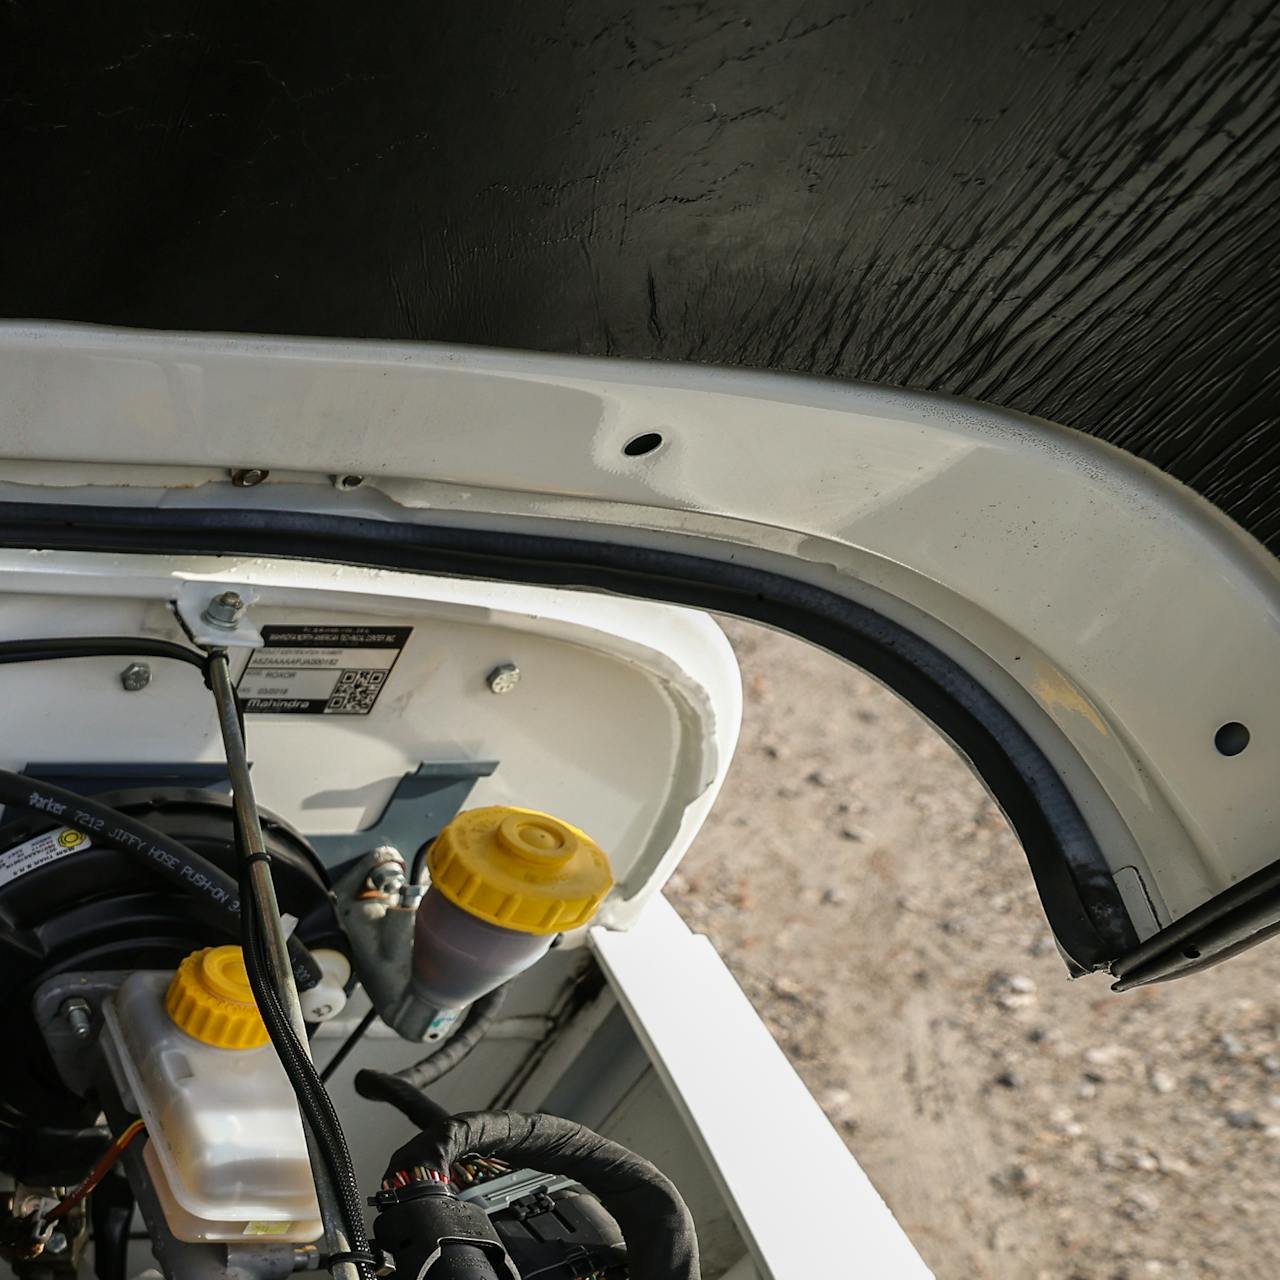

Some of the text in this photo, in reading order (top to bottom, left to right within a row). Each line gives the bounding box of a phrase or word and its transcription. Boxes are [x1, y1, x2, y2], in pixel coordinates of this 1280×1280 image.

[29, 791, 67, 816] Parker
[74, 810, 105, 831] 7212
[108, 829, 147, 851] JIFFY
[148, 845, 181, 870] HOSE
[181, 865, 230, 904] PUSH-ON
